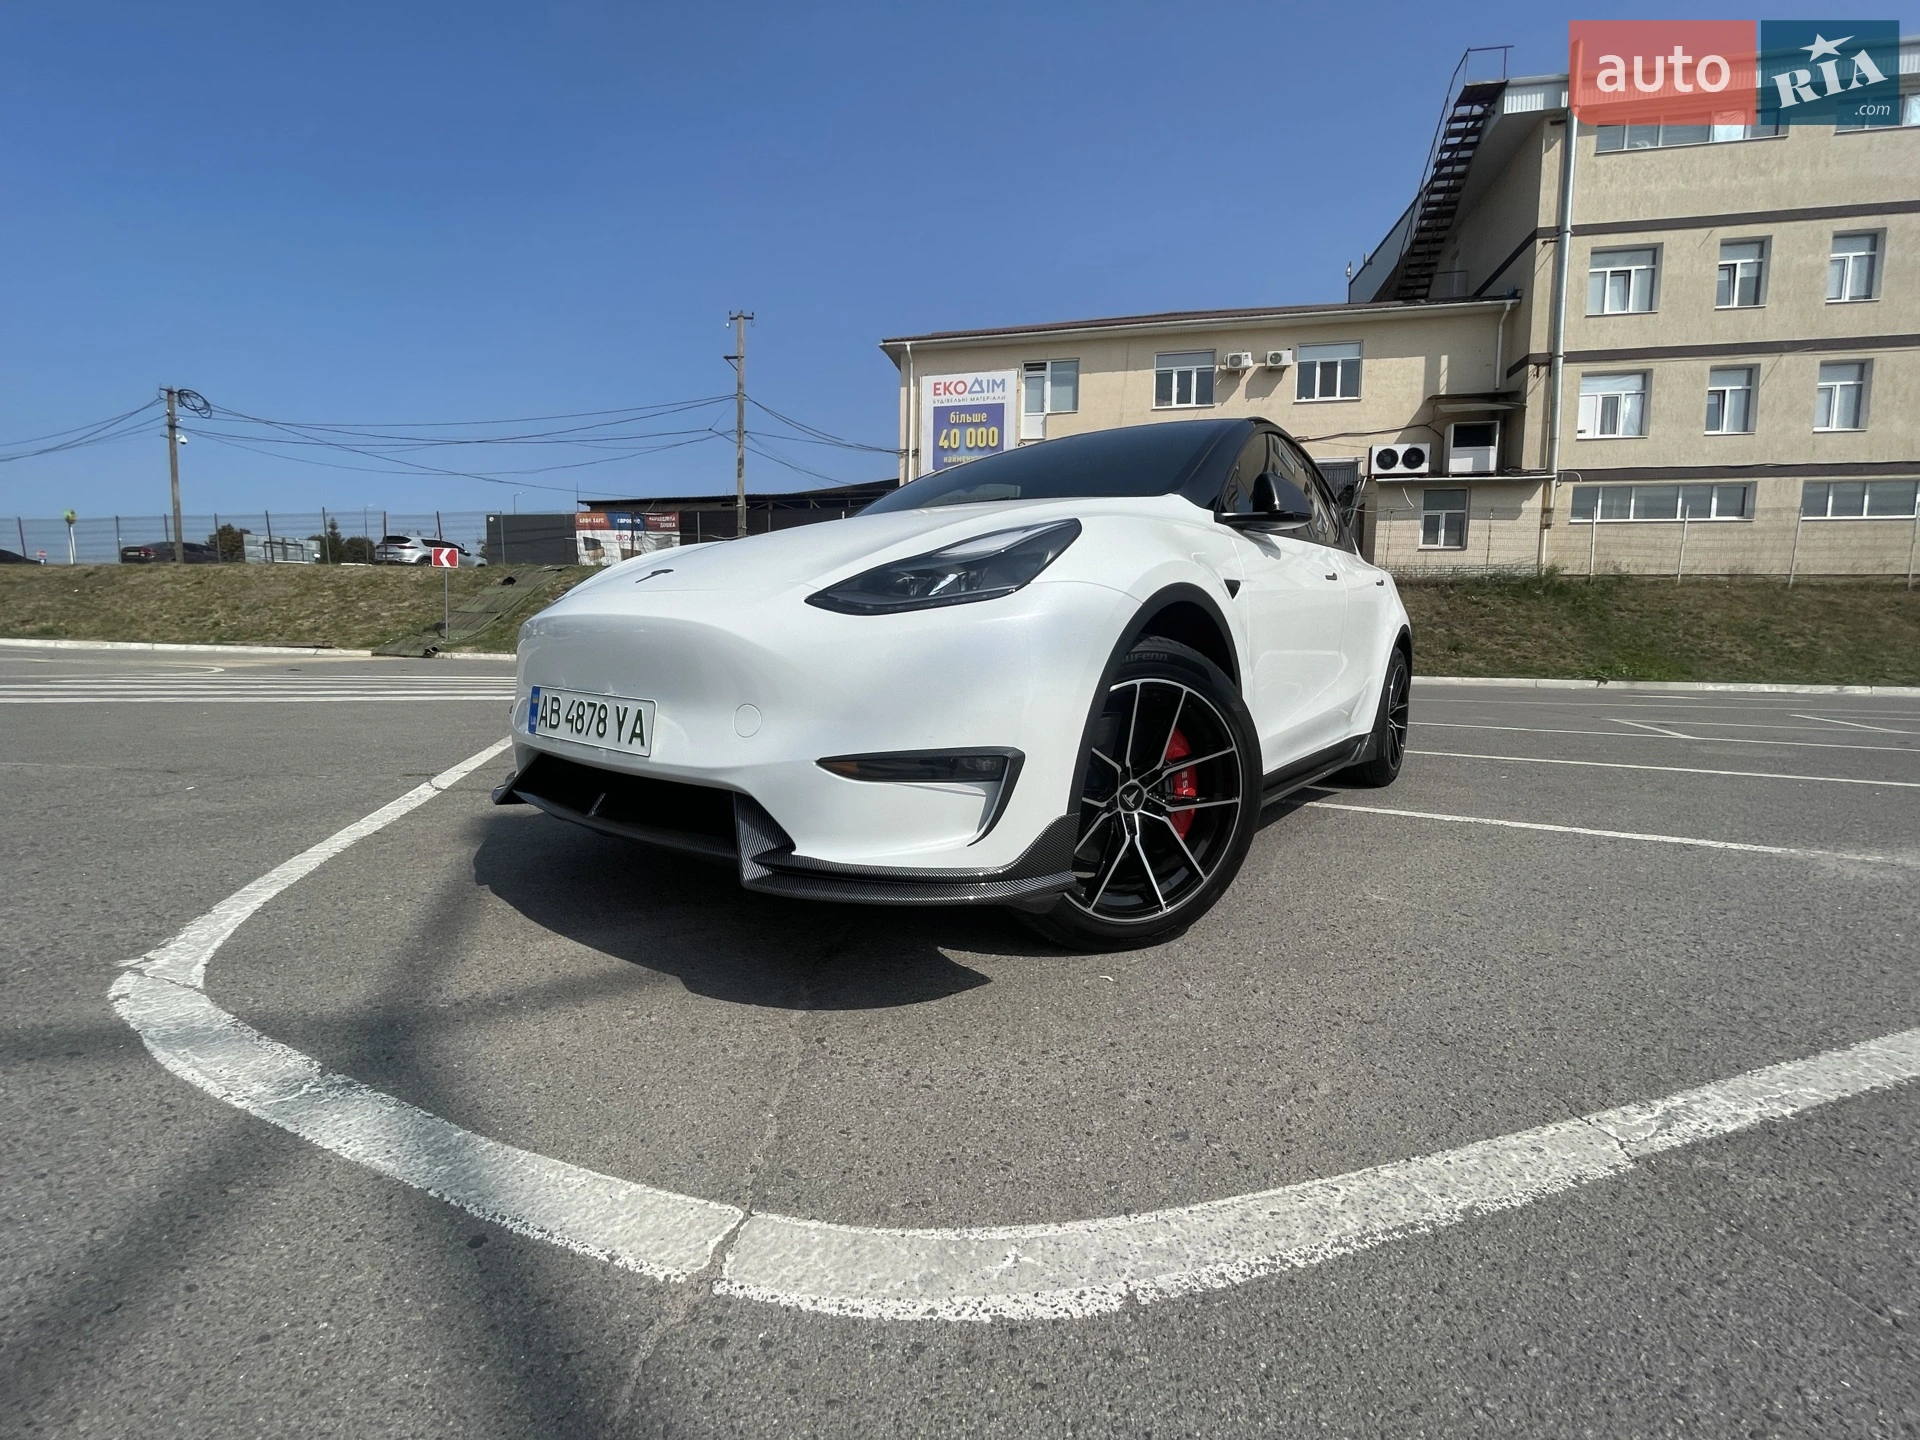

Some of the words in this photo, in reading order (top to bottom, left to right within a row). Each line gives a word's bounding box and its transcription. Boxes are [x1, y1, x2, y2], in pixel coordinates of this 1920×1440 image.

[933, 377, 1006, 397] ЕКОДІМ
[950, 411, 987, 423] більше
[938, 428, 960, 449] 40
[965, 426, 999, 448] 000
[538, 694, 562, 730] AB
[565, 699, 608, 738] 4878
[616, 705, 646, 747] YA
